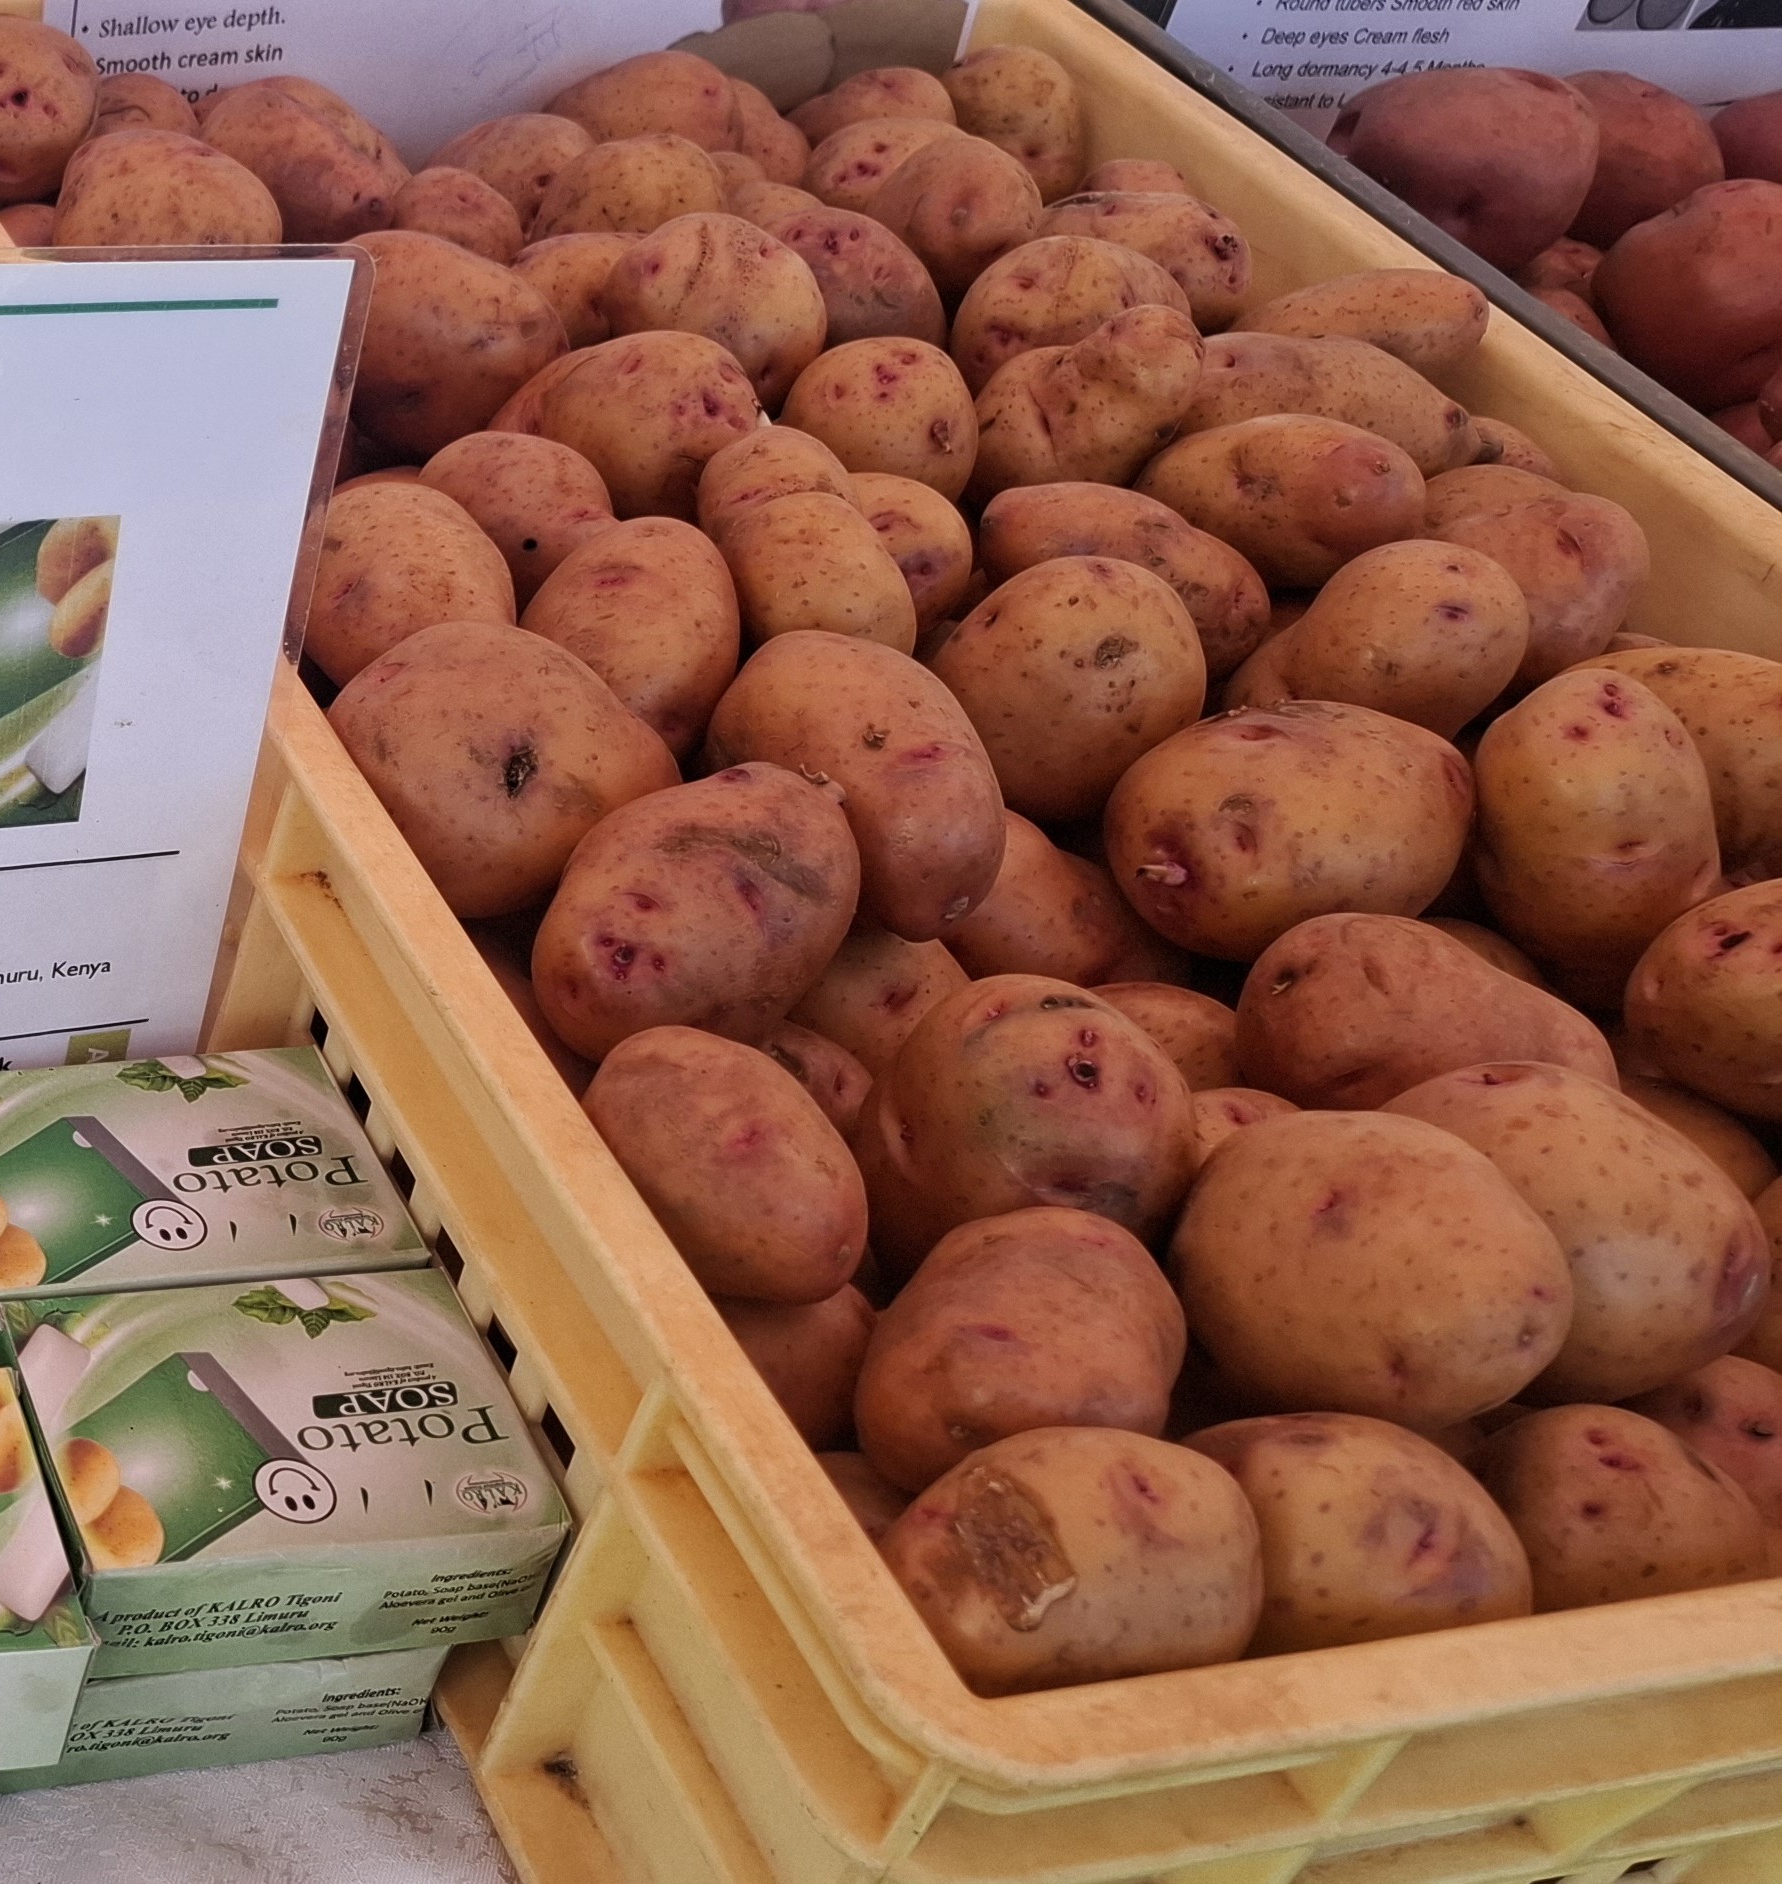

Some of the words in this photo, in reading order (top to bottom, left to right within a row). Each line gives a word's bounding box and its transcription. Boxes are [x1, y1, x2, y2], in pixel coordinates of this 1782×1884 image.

[99, 16, 179, 38] Shallow
[185, 16, 217, 35] eye
[223, 6, 285, 31] depth.
[1261, 27, 1306, 48] Deep
[1309, 31, 1349, 49] eyes
[1354, 27, 1408, 45] Cream
[1411, 27, 1450, 44] flesh
[96, 51, 171, 74] Smooth
[178, 51, 238, 68] cream
[245, 44, 283, 63] skin
[1252, 60, 1294, 81] Long
[1297, 60, 1379, 80] dormancy
[52, 961, 110, 979] Kenya
[213, 1137, 319, 1163] SOAP
[173, 1155, 369, 1193] Potato
[339, 1384, 455, 1416] SOAP
[297, 1405, 510, 1452] Potato
[431, 1568, 513, 1583] Ingredients:
[94, 1611, 109, 1622] A
[109, 1608, 182, 1625] product
[184, 1603, 207, 1617] of
[206, 1595, 281, 1614] KALRO
[285, 1591, 343, 1608] Tigoni
[117, 1623, 152, 1636] P.O.
[158, 1616, 208, 1632] BOX
[208, 1615, 239, 1627] 338
[242, 1610, 310, 1624] Limuru
[143, 1621, 338, 1648] kalro.tigoni@kalro.org
[322, 1688, 402, 1702] Ingredients:
